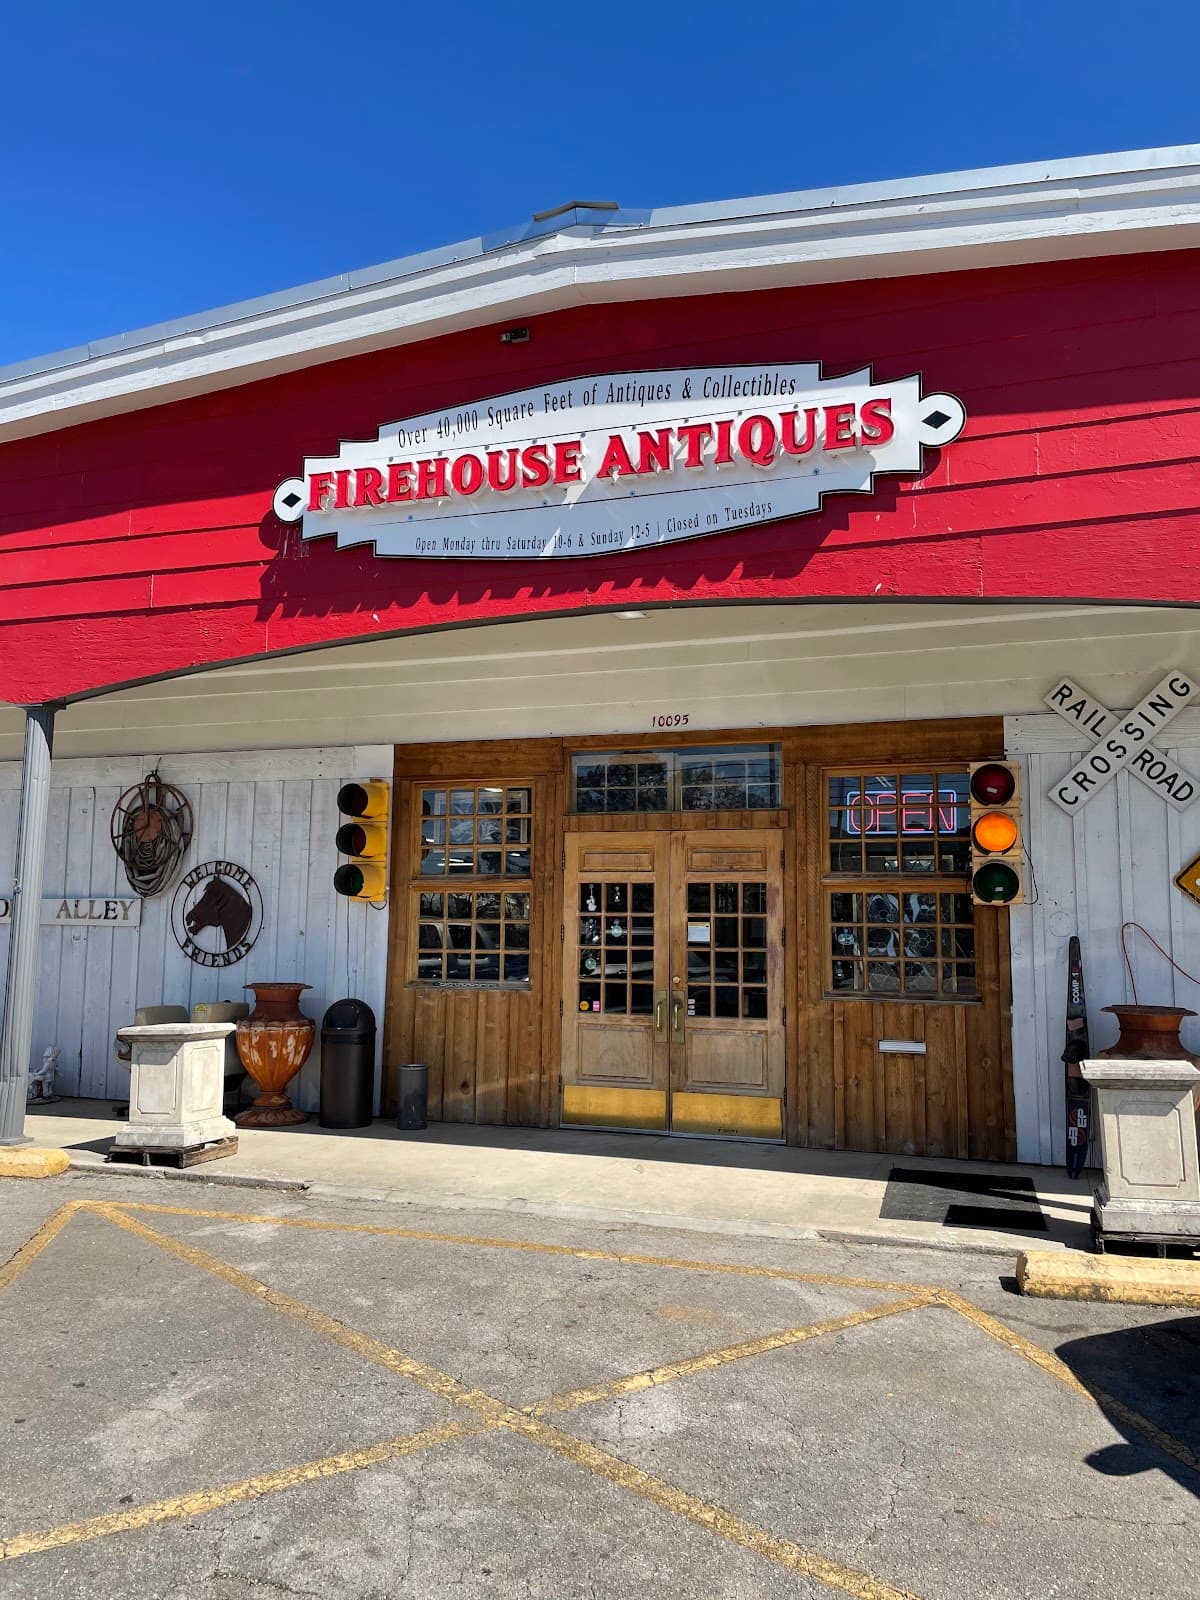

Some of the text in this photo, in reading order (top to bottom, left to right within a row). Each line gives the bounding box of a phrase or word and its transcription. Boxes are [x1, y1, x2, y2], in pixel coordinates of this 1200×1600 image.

[397, 373, 797, 449] Over 40,000 Square Feet of Antiques & Collectibles
[307, 397, 895, 512] FIREHOUSE ANTIQUES
[416, 501, 773, 554] Open Monday thru Saturday 10-6 & Sunday 12-5 Closed on Tuesdays
[652, 714, 689, 728] 10095
[1051, 684, 1194, 802] RAIL ROAD
[1058, 677, 1191, 805] CROSSING
[850, 793, 954, 832] OPEN
[183, 861, 254, 890] WELCOME
[56, 899, 136, 920] ALLEY
[182, 937, 251, 967] FRIENDS
[1072, 979, 1080, 1004] COMP
